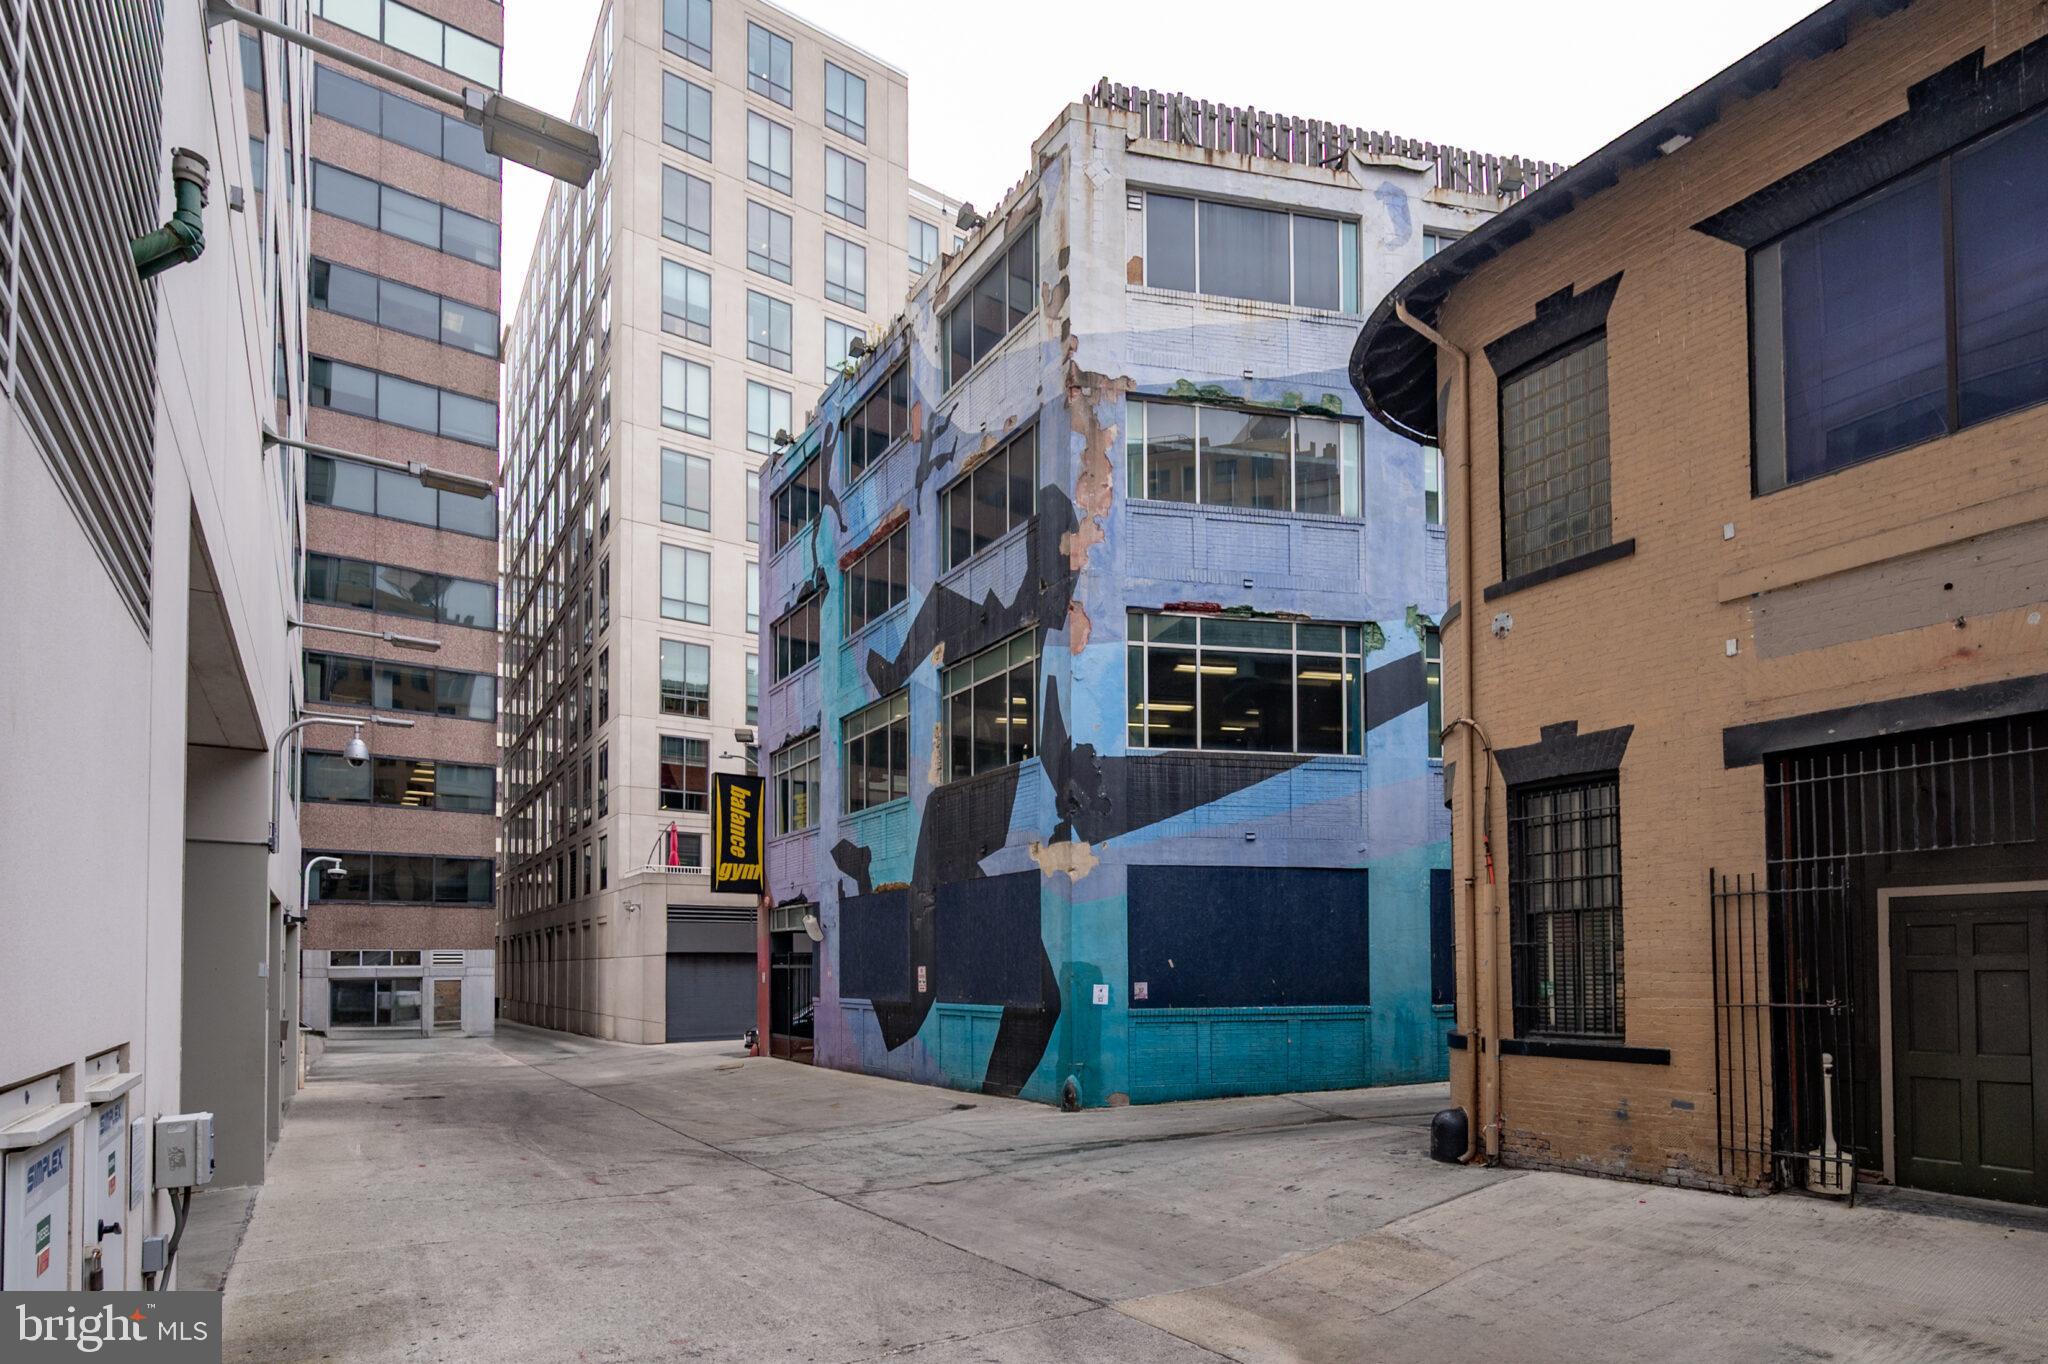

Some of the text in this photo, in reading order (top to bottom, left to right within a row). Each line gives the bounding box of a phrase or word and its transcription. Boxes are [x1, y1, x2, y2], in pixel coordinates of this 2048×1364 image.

[730, 784, 752, 859] balance
[718, 862, 760, 881] gym
[27, 1146, 64, 1194] SIMPLEX
